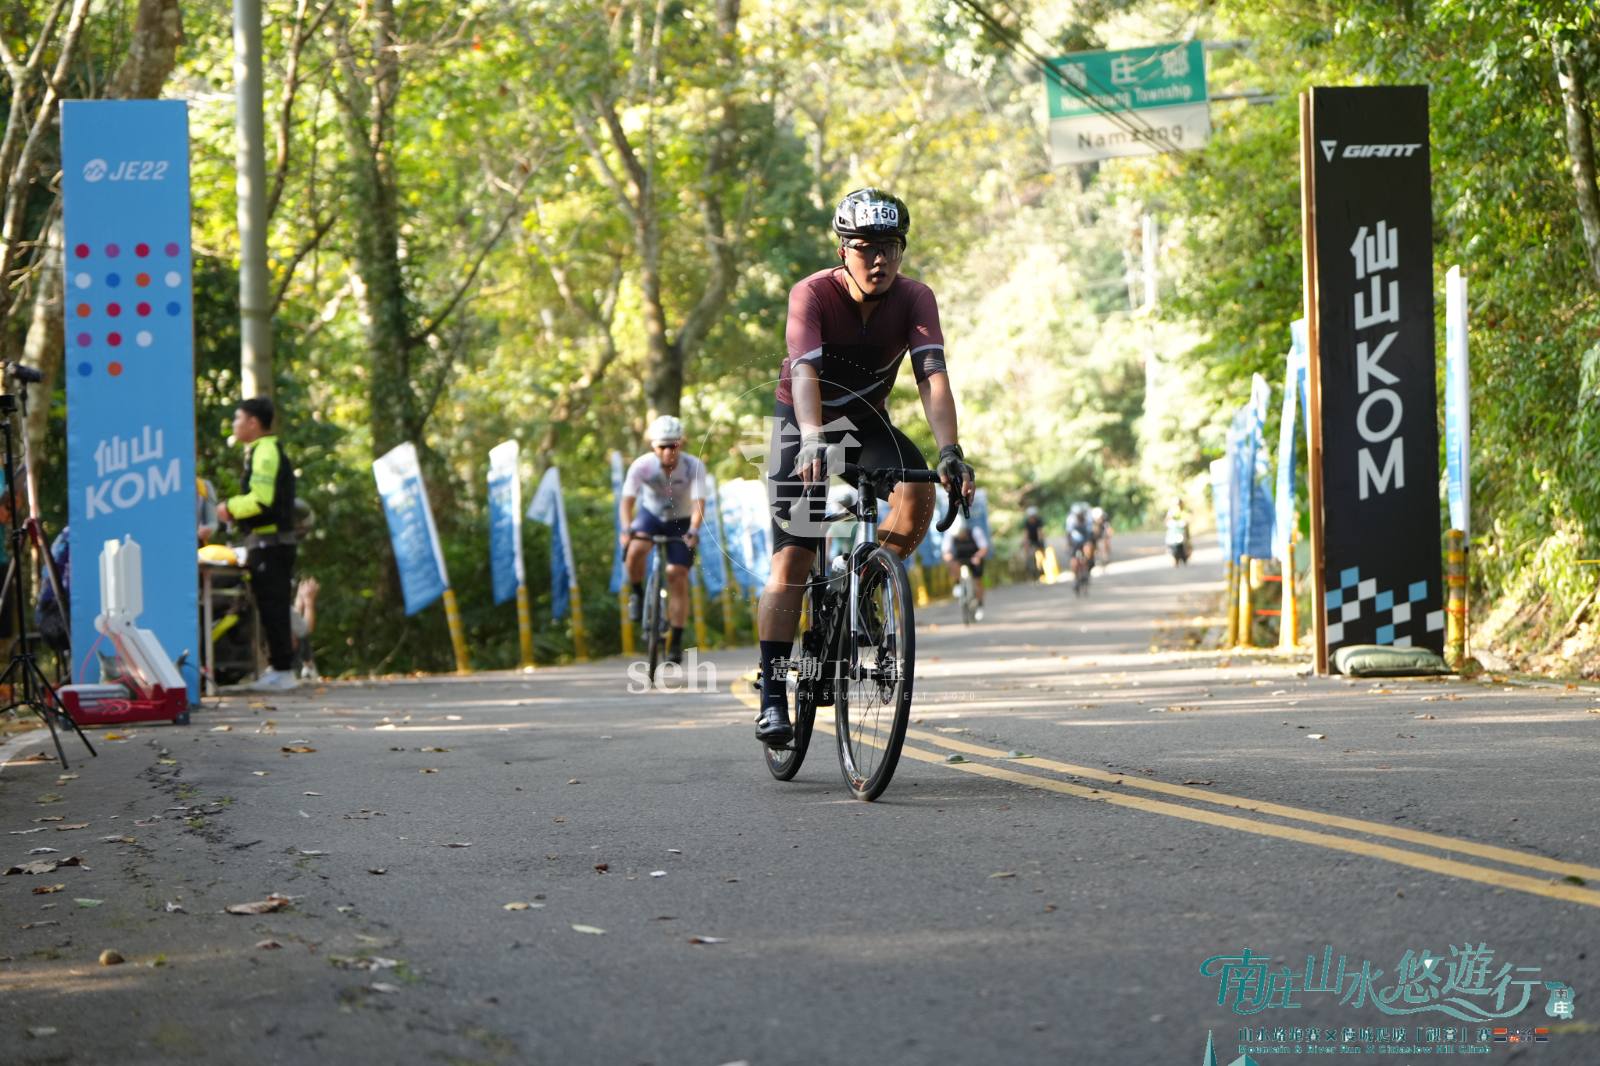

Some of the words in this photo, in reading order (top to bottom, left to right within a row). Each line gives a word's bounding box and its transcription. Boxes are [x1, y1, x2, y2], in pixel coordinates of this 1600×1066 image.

[1134, 84, 1192, 102] Township
[1342, 143, 1422, 158] GIANT
[108, 160, 169, 181] JE22
[94, 425, 163, 478] 仙山
[86, 458, 181, 520] KOM
